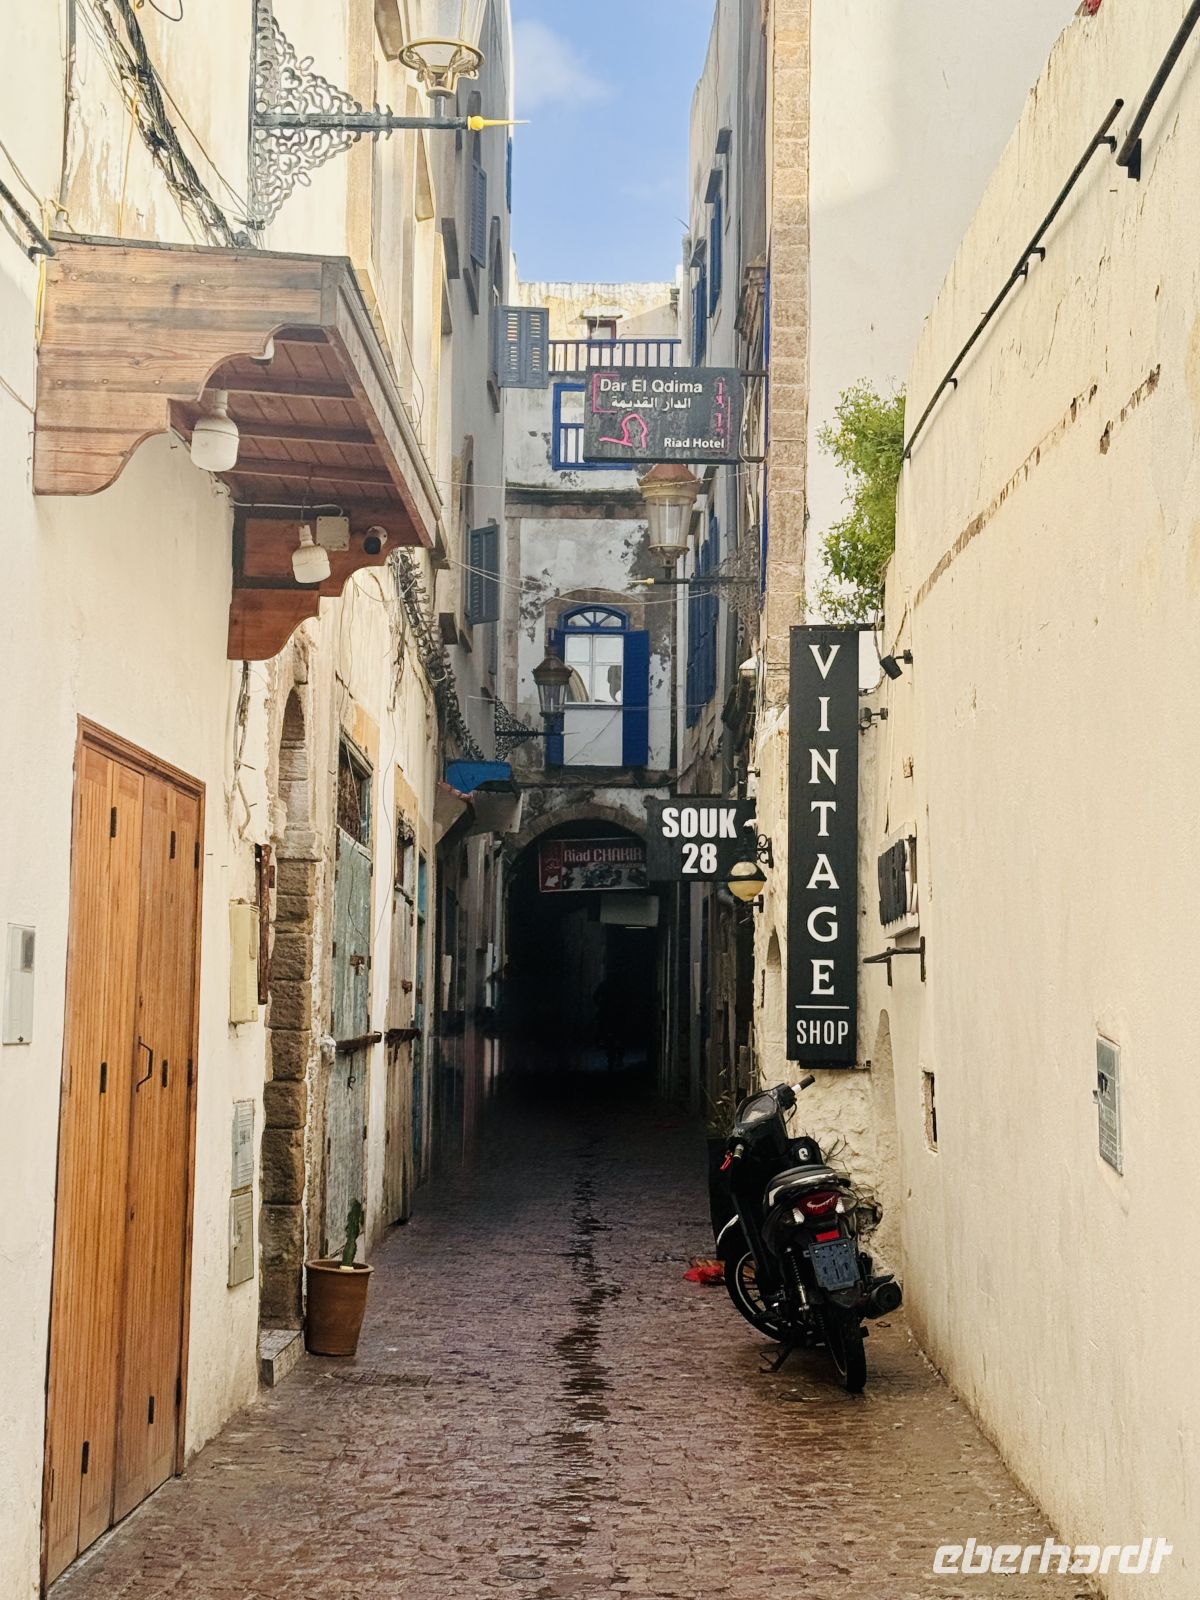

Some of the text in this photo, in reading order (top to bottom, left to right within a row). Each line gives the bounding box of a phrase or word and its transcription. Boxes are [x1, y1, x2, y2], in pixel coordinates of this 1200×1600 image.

[600, 379, 703, 393] Dar El Qdima
[611, 395, 691, 411] الدار القديمة
[664, 437, 725, 449] Riad Hotel
[661, 807, 738, 839] SOUK
[806, 644, 840, 996] VINTAGE
[564, 848, 591, 863] Riad
[681, 843, 718, 874] 28
[796, 1019, 849, 1046] SHOP
